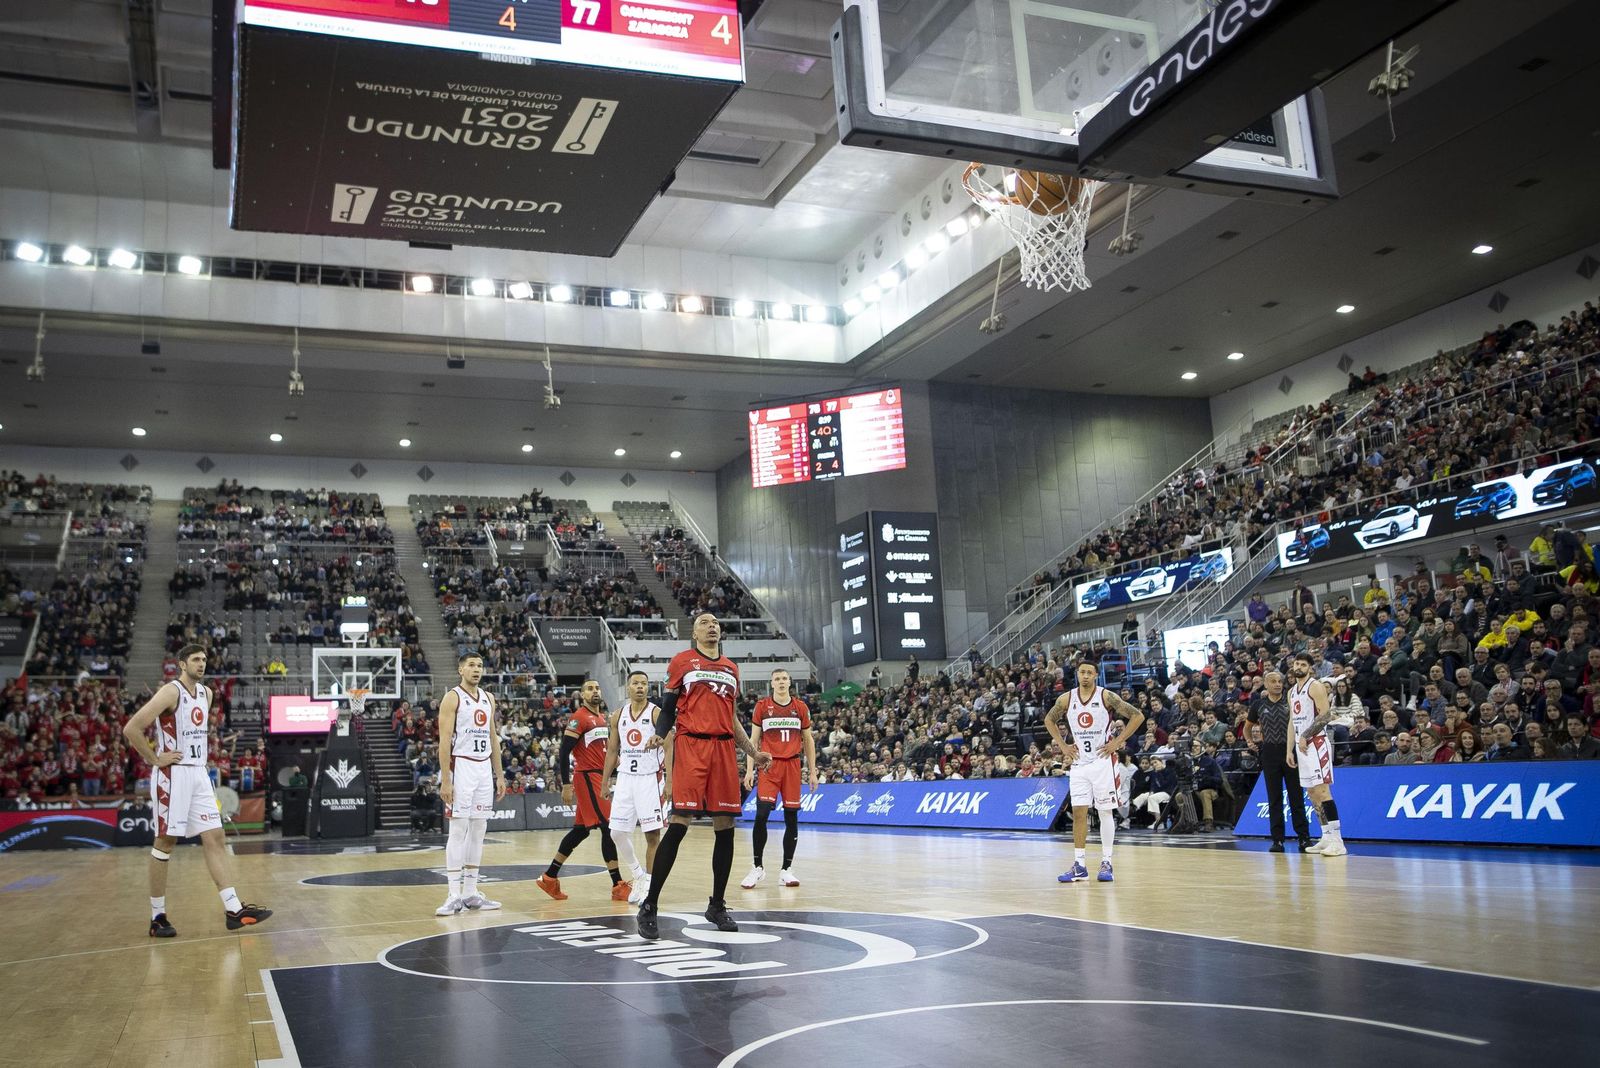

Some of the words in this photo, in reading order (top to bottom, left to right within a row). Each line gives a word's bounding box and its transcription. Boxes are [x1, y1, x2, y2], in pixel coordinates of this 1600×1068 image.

[498, 7, 517, 31] 4
[710, 15, 732, 45] 4
[490, 53, 532, 65] MONDO
[355, 82, 413, 94] CULTURA
[416, 89, 430, 98] LA
[447, 82, 516, 97] CANDIDATA
[432, 91, 449, 99] DE
[451, 93, 511, 106] EUROPEA
[517, 91, 563, 101] CIUDAD
[513, 100, 558, 110] CAPITAL
[461, 107, 553, 131] 2031
[384, 204, 465, 221] 2031
[380, 222, 419, 230] CIUDAD
[421, 226, 475, 234] CANDIDATA
[382, 217, 423, 225] CAPITAL
[425, 221, 472, 229] EUROPEA
[817, 426, 831, 436] 4Q
[831, 459, 839, 469] 4
[780, 730, 790, 742] 11
[473, 739, 487, 753] 19
[1083, 740, 1092, 753] 3
[630, 759, 638, 772] 2
[321, 798, 339, 806] CAJA
[916, 792, 989, 814] KAYAK
[1386, 782, 1577, 821] KAYAK
[513, 921, 788, 977] PULEVA
